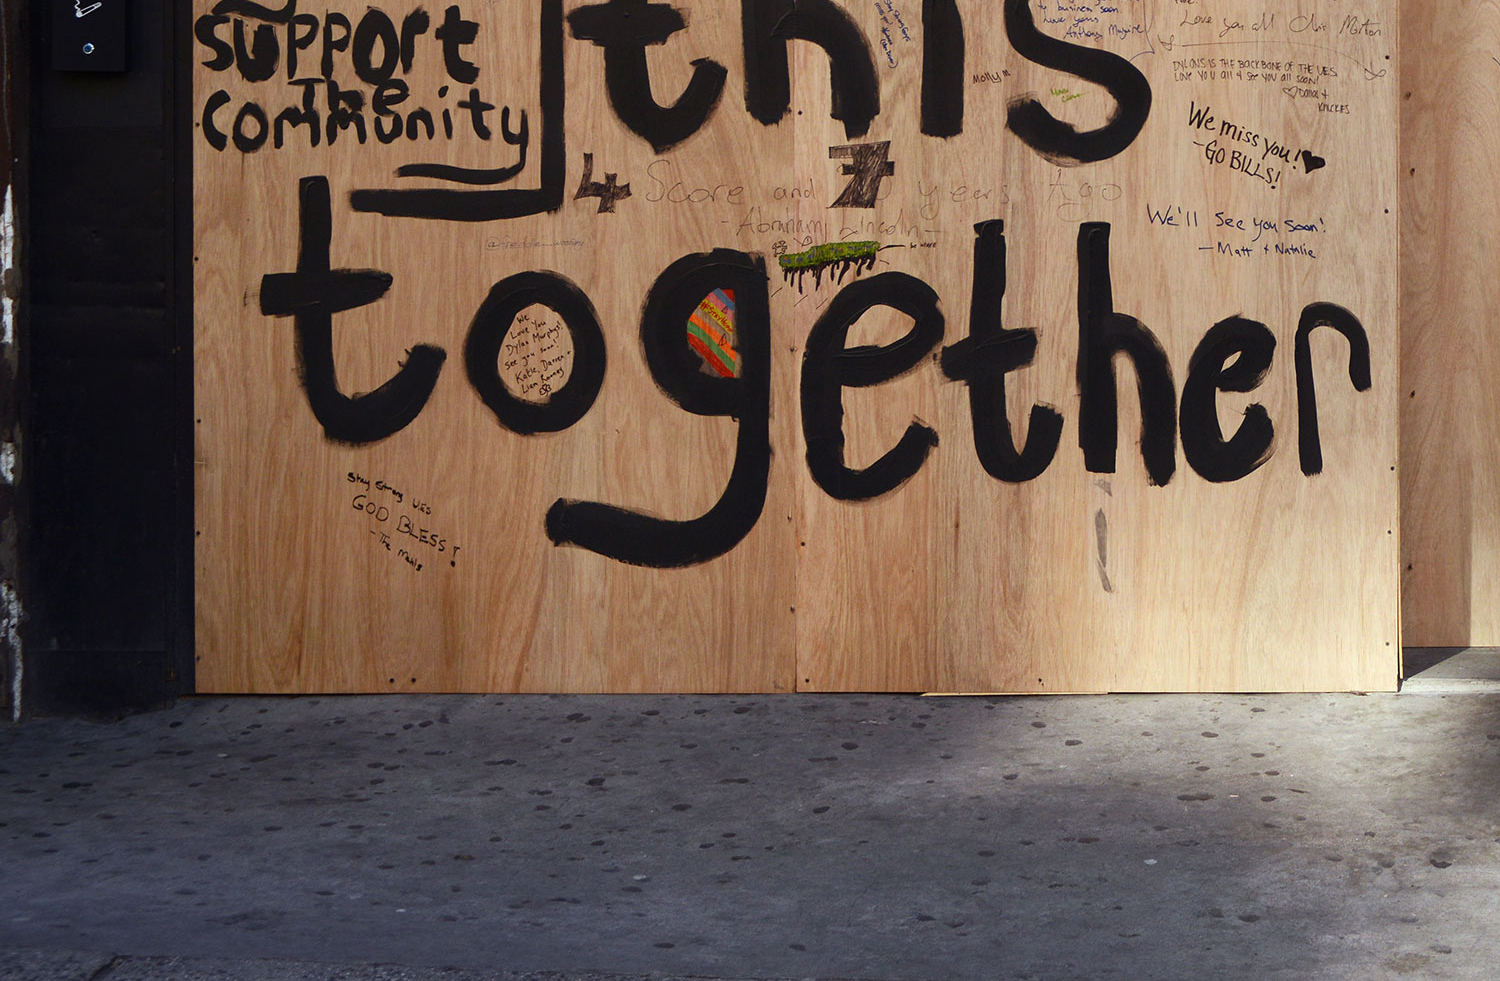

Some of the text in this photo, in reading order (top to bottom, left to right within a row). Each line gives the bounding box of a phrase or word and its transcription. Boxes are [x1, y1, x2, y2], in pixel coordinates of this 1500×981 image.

[1180, 9, 1212, 27] Love
[1251, 12, 1274, 32] all
[1188, 101, 1216, 133] We
[1219, 120, 1259, 147] miss
[1230, 150, 1281, 189] BILLS!
[573, 152, 632, 213] 4
[645, 159, 745, 205] Score
[773, 178, 816, 200] and
[918, 179, 1010, 220] years
[1147, 204, 1198, 227] We'll
[1215, 212, 1246, 231] See
[1253, 217, 1278, 242] you
[506, 339, 529, 356] Dylan
[510, 327, 530, 339] Love
[259, 175, 1371, 568] together
[521, 352, 535, 367] you
[352, 494, 389, 521] GOD
